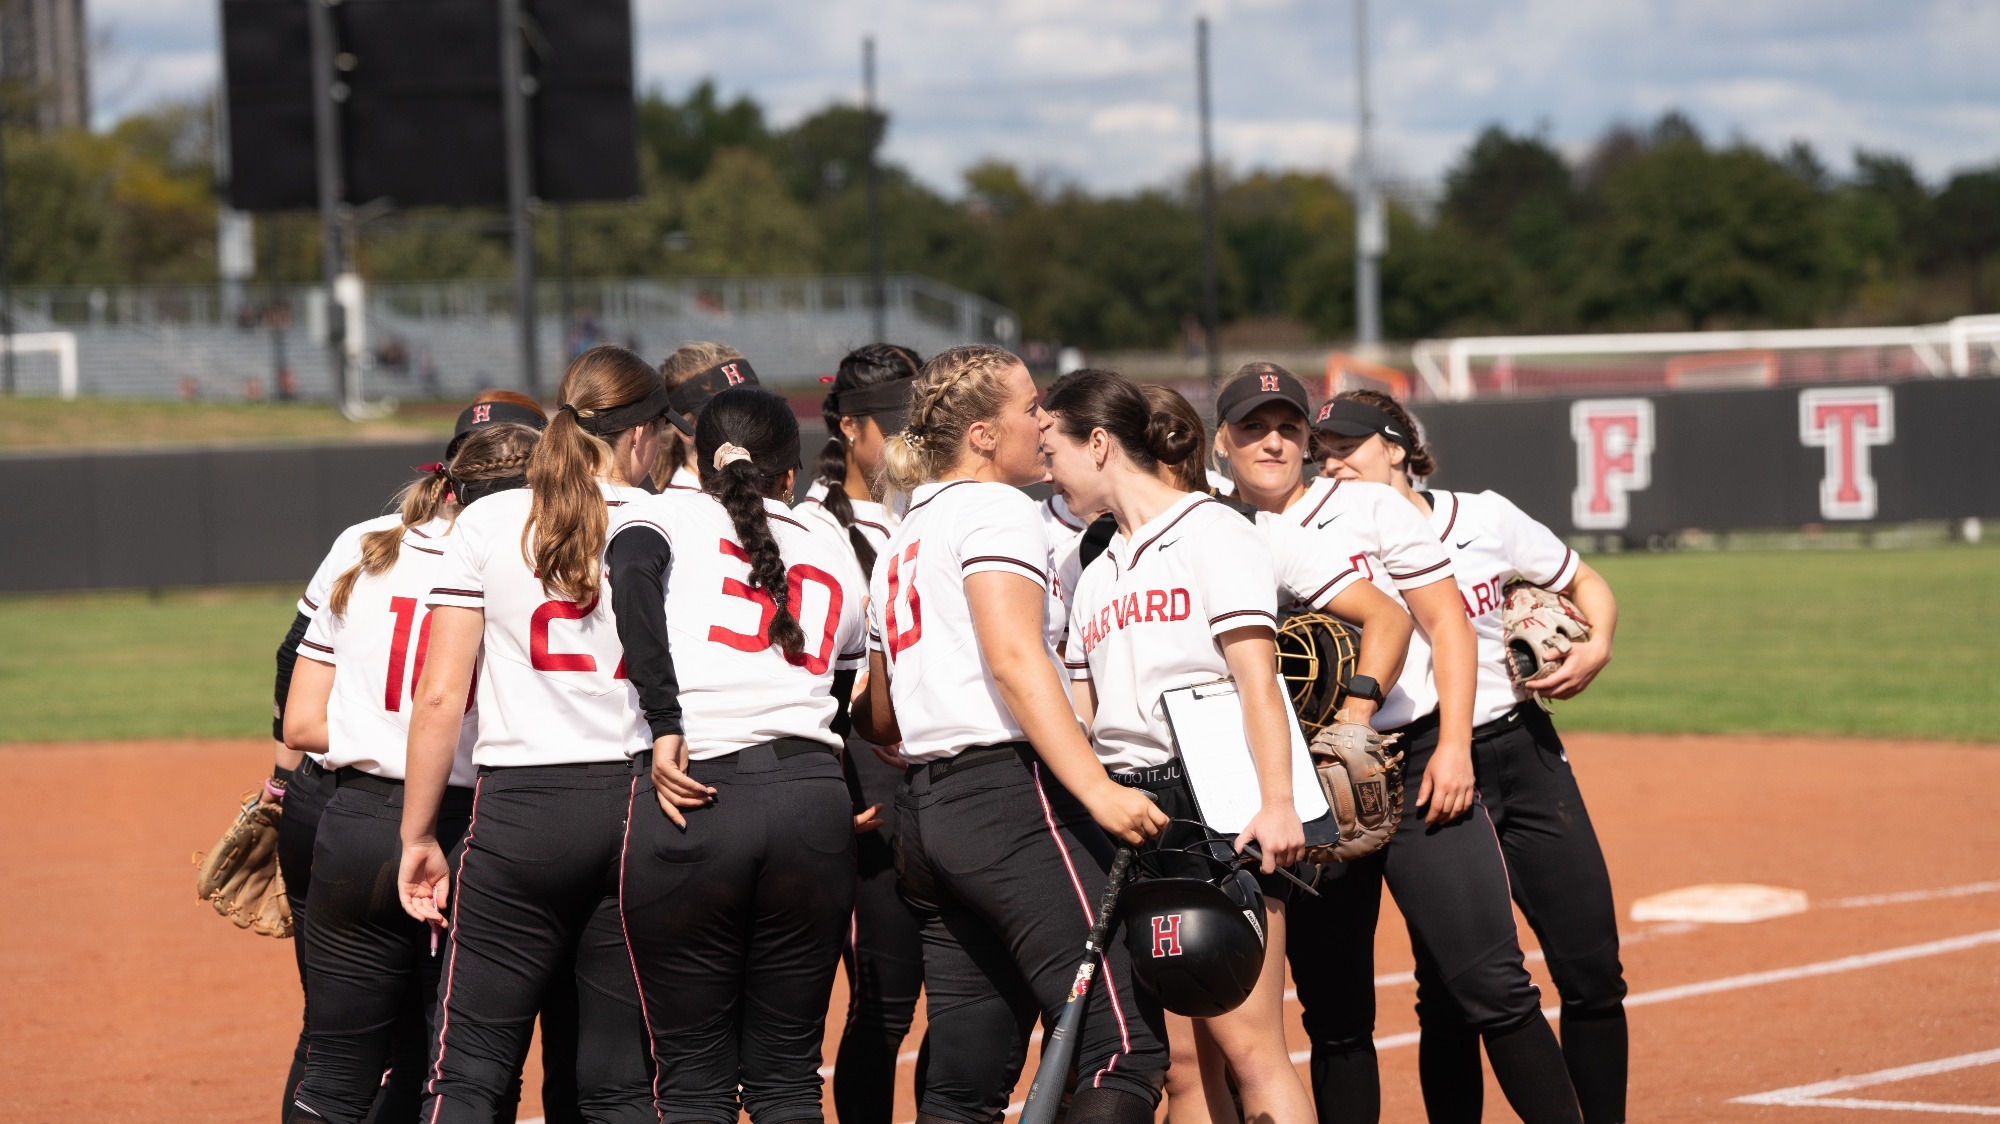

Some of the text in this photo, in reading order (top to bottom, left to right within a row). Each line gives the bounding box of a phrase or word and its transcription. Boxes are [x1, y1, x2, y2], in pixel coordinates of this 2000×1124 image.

[721, 363, 744, 386] H
[1259, 374, 1280, 392] H
[472, 404, 490, 424] H
[1315, 403, 1334, 424] H
[708, 538, 843, 675] 30
[1081, 588, 1190, 654] HARVARD
[1151, 914, 1182, 958] H
